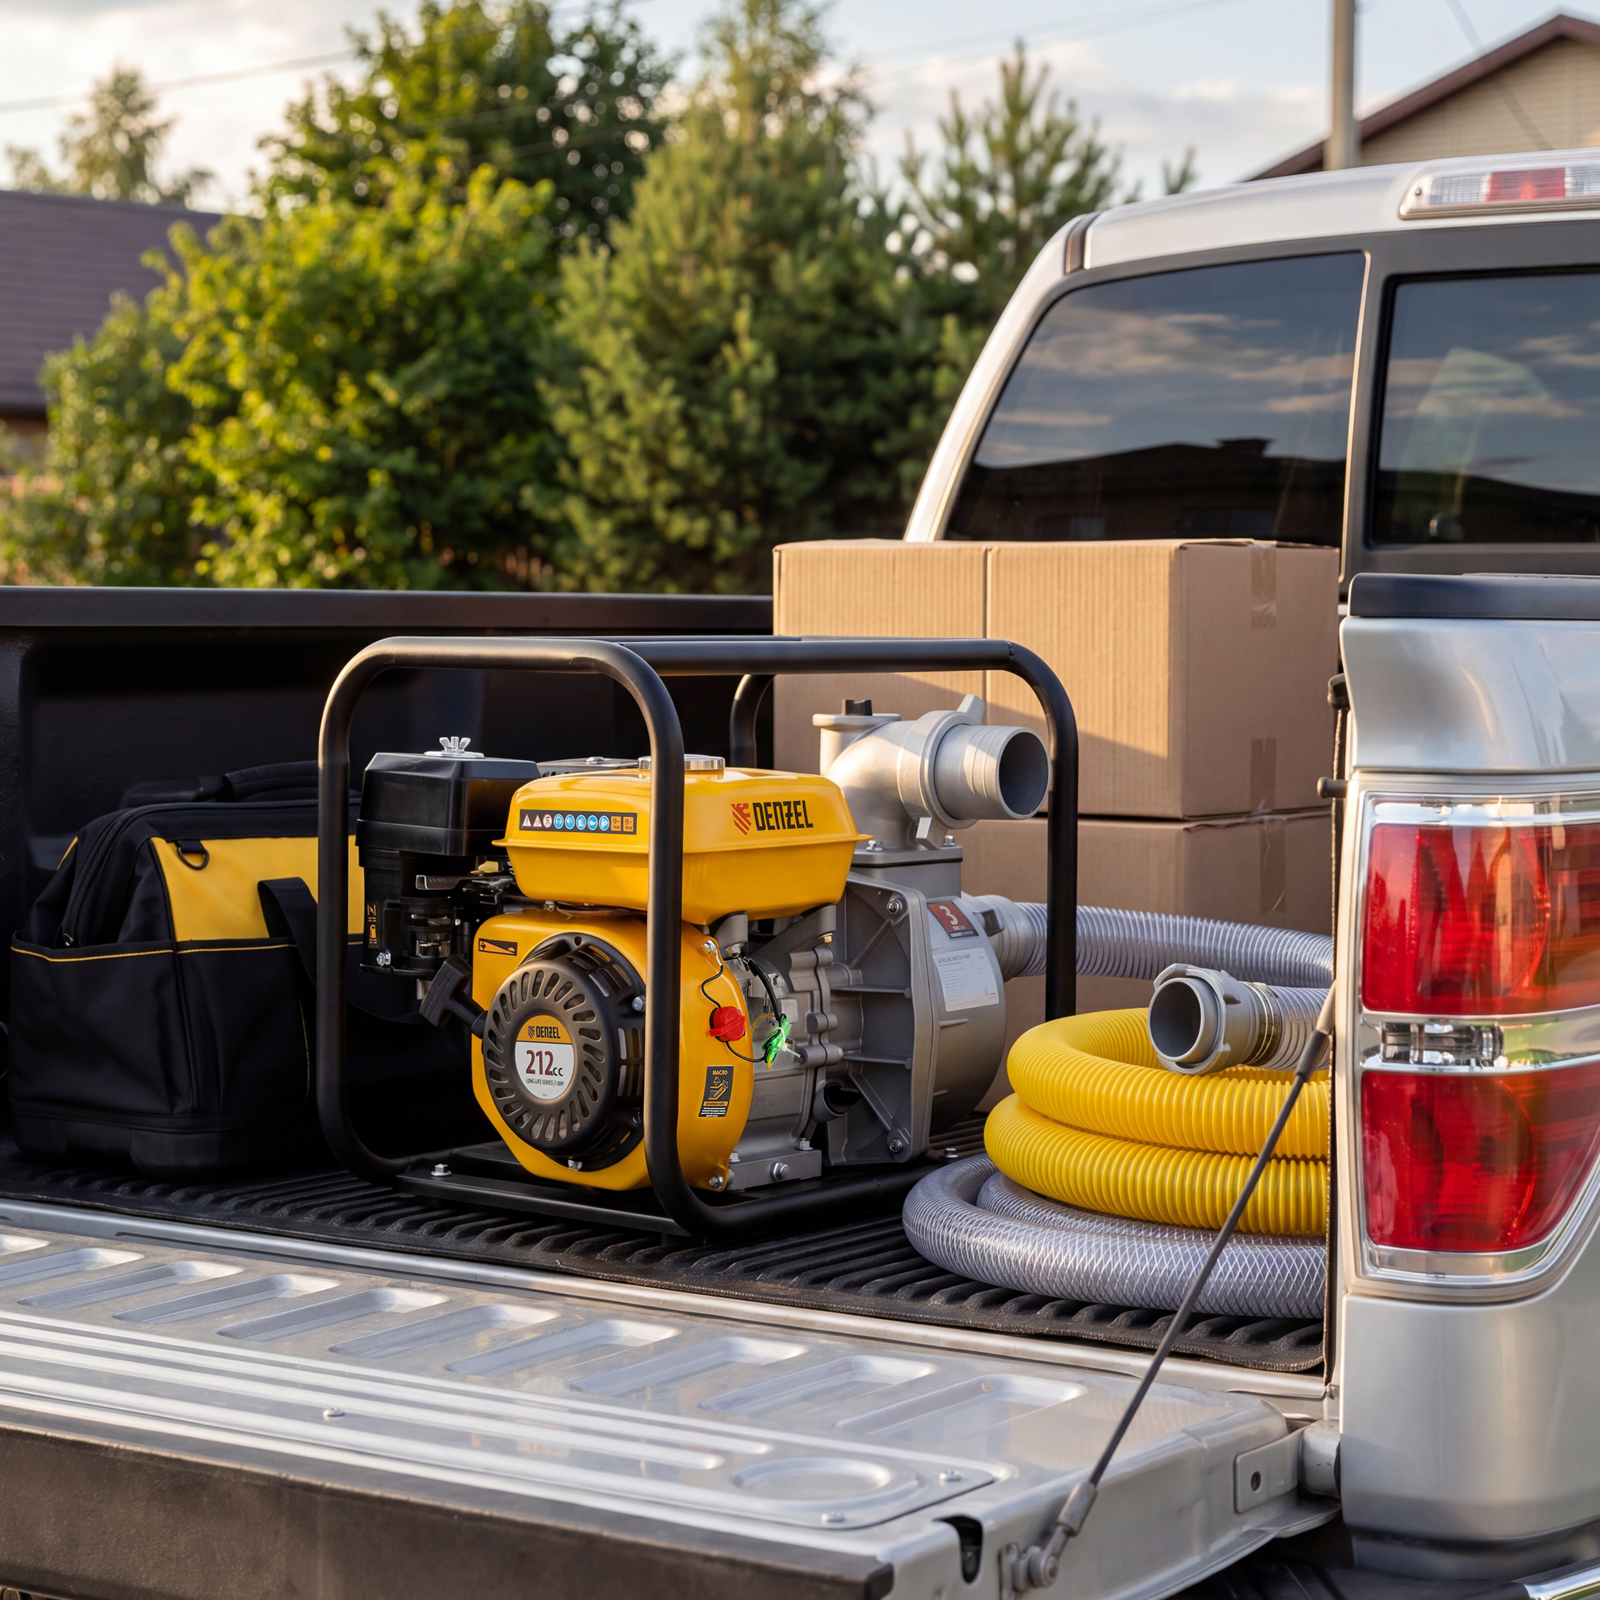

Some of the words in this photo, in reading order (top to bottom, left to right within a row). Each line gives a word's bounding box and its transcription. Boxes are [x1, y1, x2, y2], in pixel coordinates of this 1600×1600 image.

[752, 800, 814, 831] DENZEL
[939, 905, 958, 925] 3
[536, 1025, 561, 1039] DENZEL
